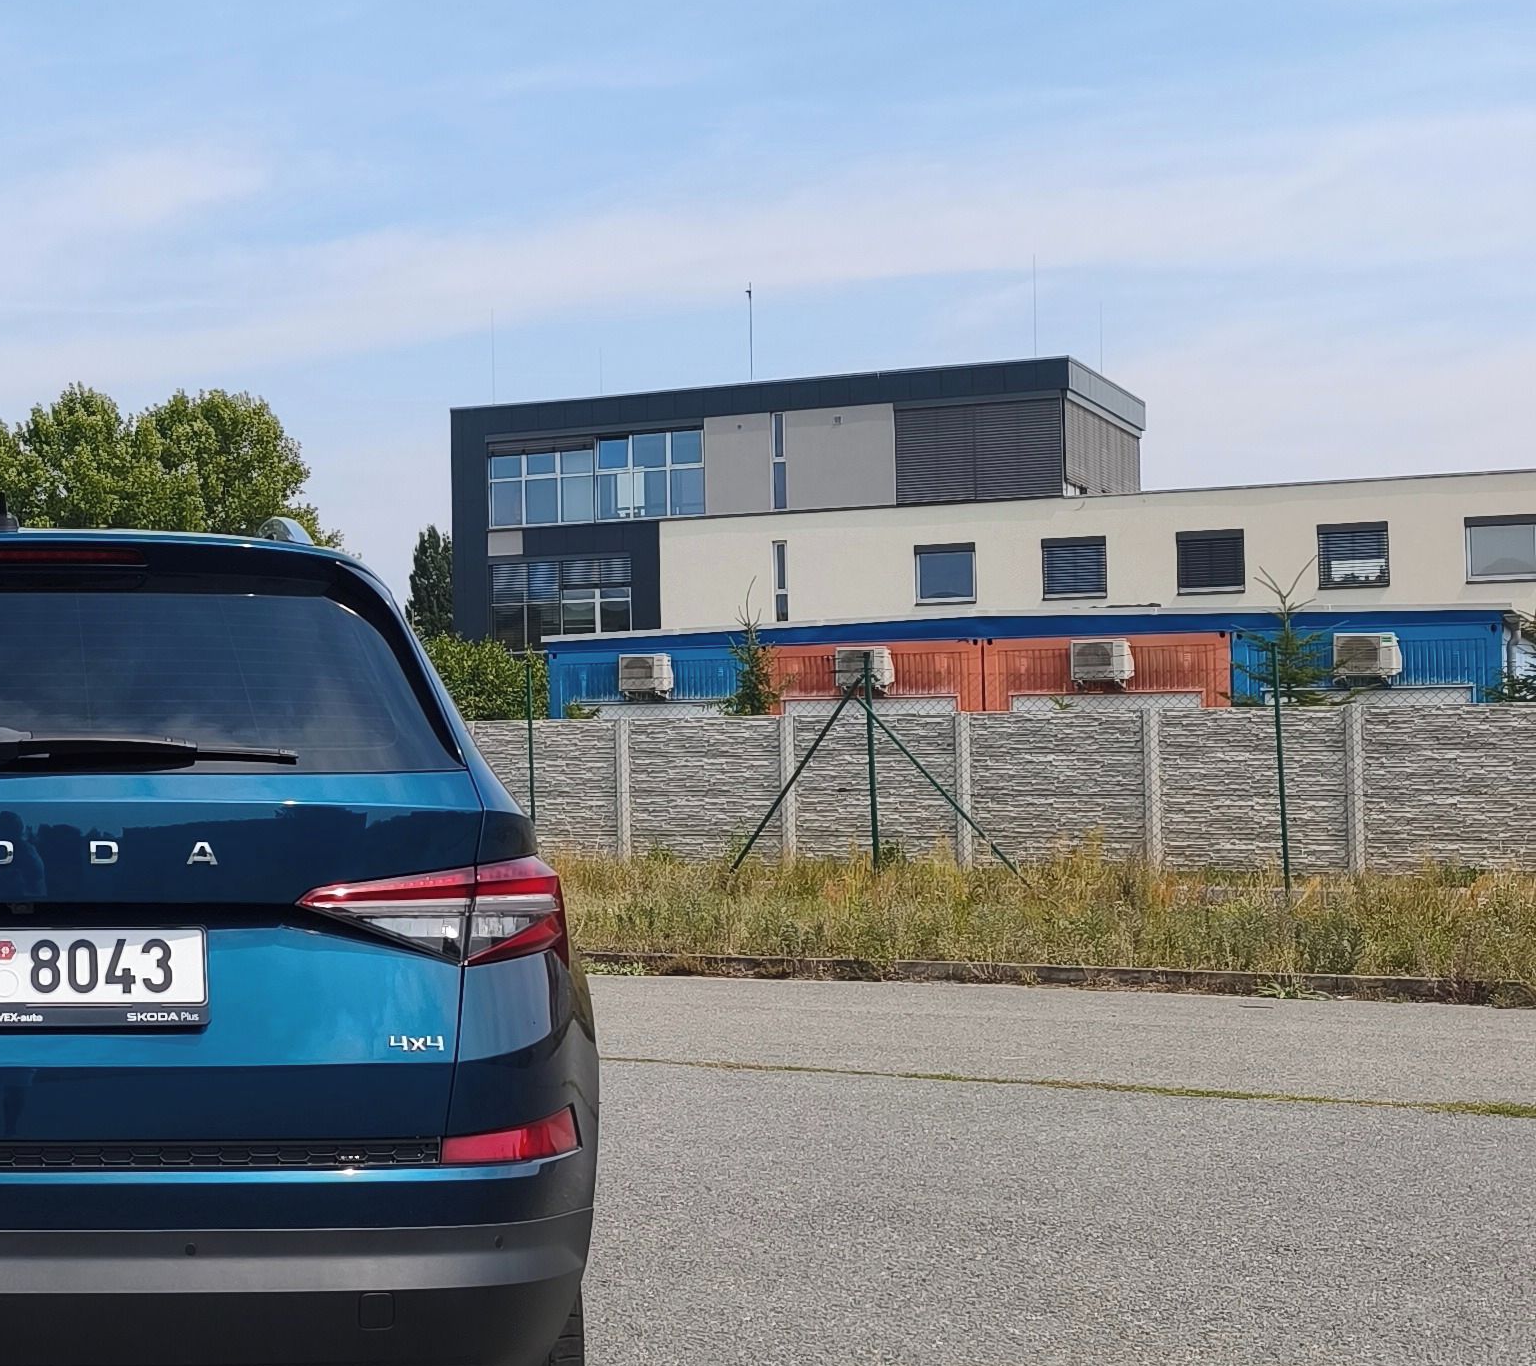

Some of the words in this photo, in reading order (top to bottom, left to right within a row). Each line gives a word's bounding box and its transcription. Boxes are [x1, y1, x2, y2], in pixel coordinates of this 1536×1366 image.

[30, 938, 173, 994] 8043
[126, 1012, 178, 1022] SKODA
[181, 1011, 199, 1021] Plus
[389, 1035, 444, 1051] 4x4
